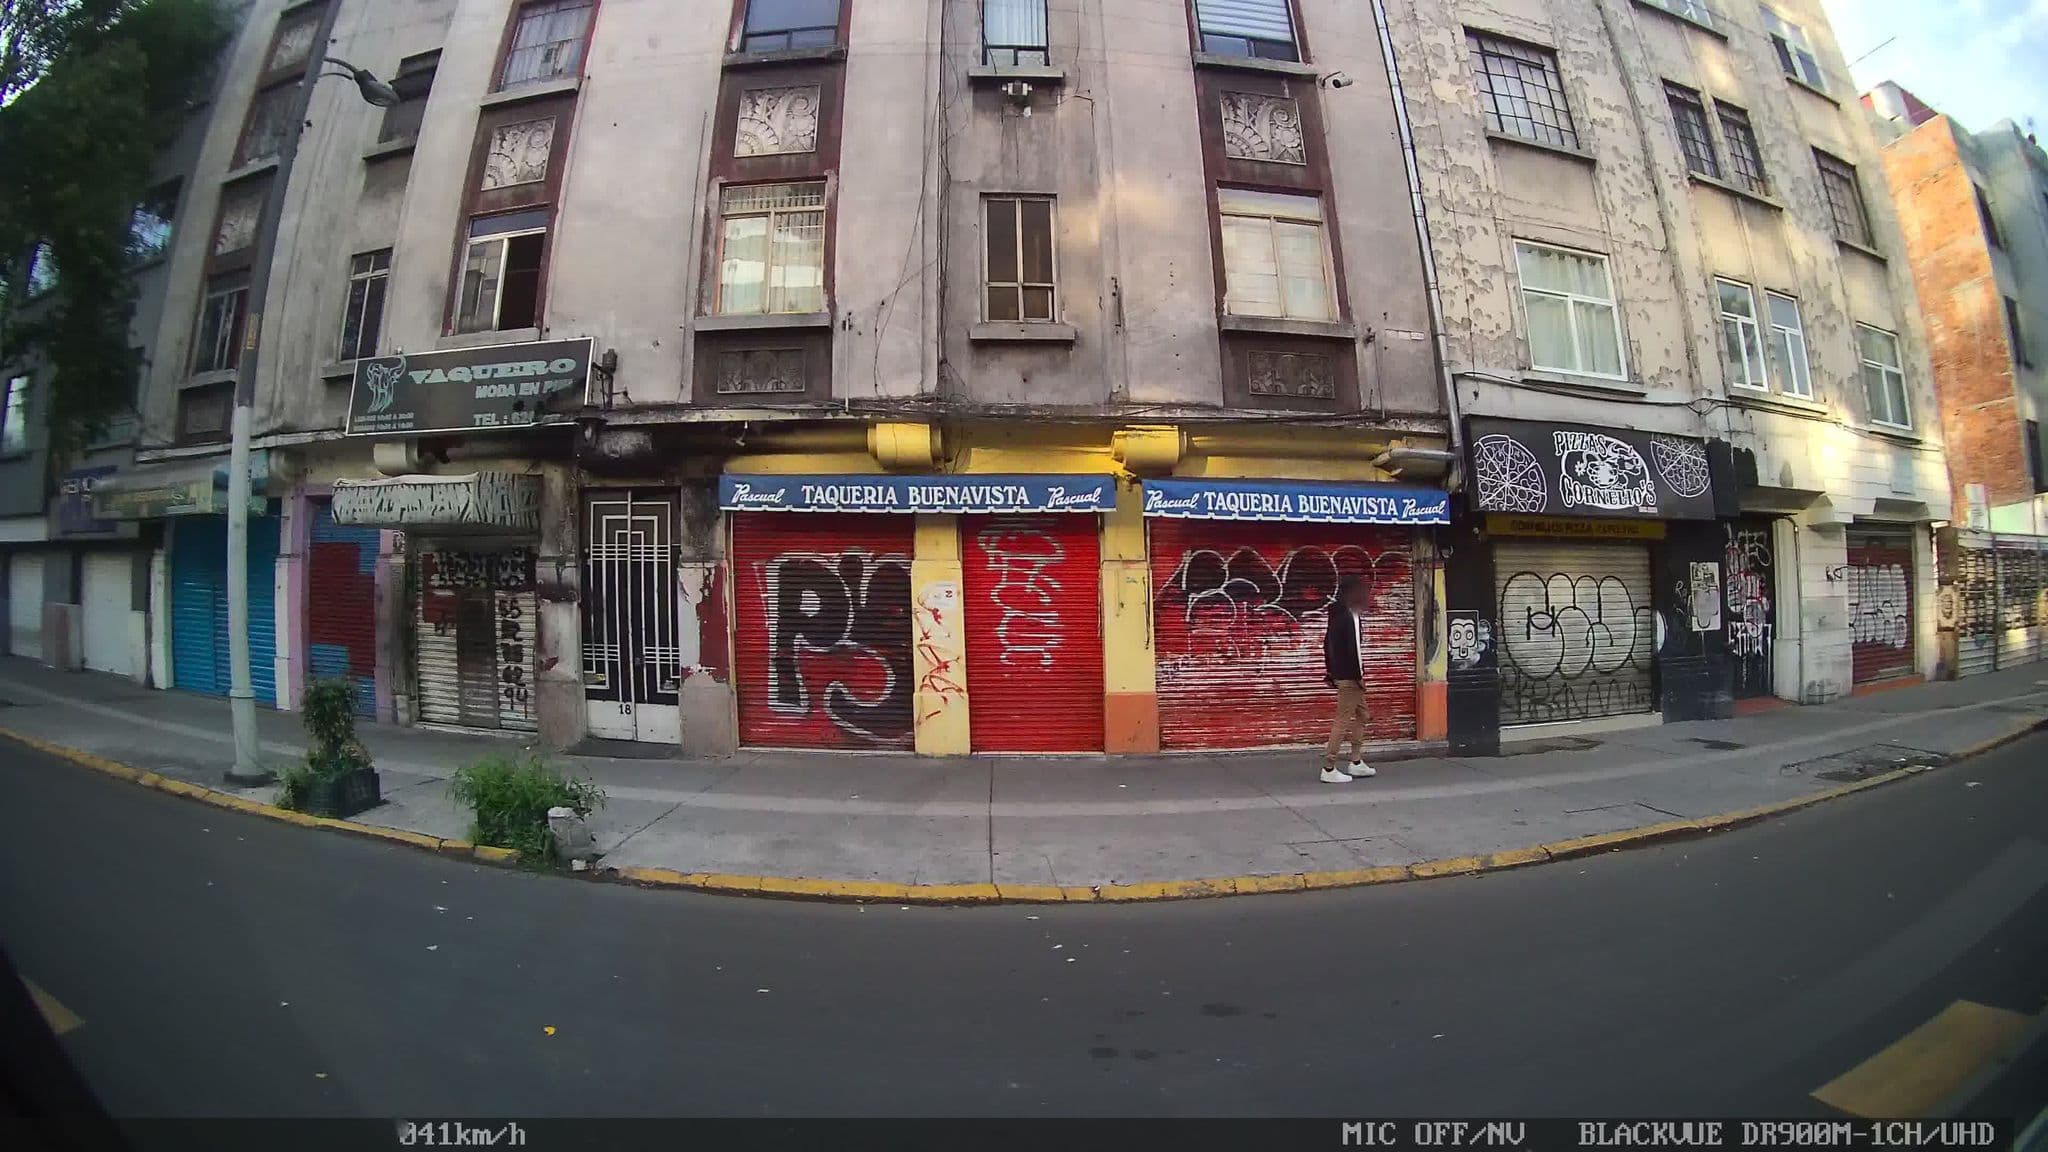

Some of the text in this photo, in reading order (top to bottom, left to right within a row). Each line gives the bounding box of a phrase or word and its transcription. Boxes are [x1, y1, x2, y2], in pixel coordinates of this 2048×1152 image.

[408, 358, 577, 385] VAQUERO
[475, 383, 516, 399] MODA
[519, 381, 540, 396] EN
[1553, 431, 1609, 456] PIZZAS
[731, 483, 1102, 509] Pascual TAQUERIA BUENAVISTA Pascual
[1145, 489, 1446, 518] Pascual TAQUERIA BUENAVISTA Pascual
[1559, 475, 1657, 508] CORNELIO'S
[618, 703, 632, 715] 18
